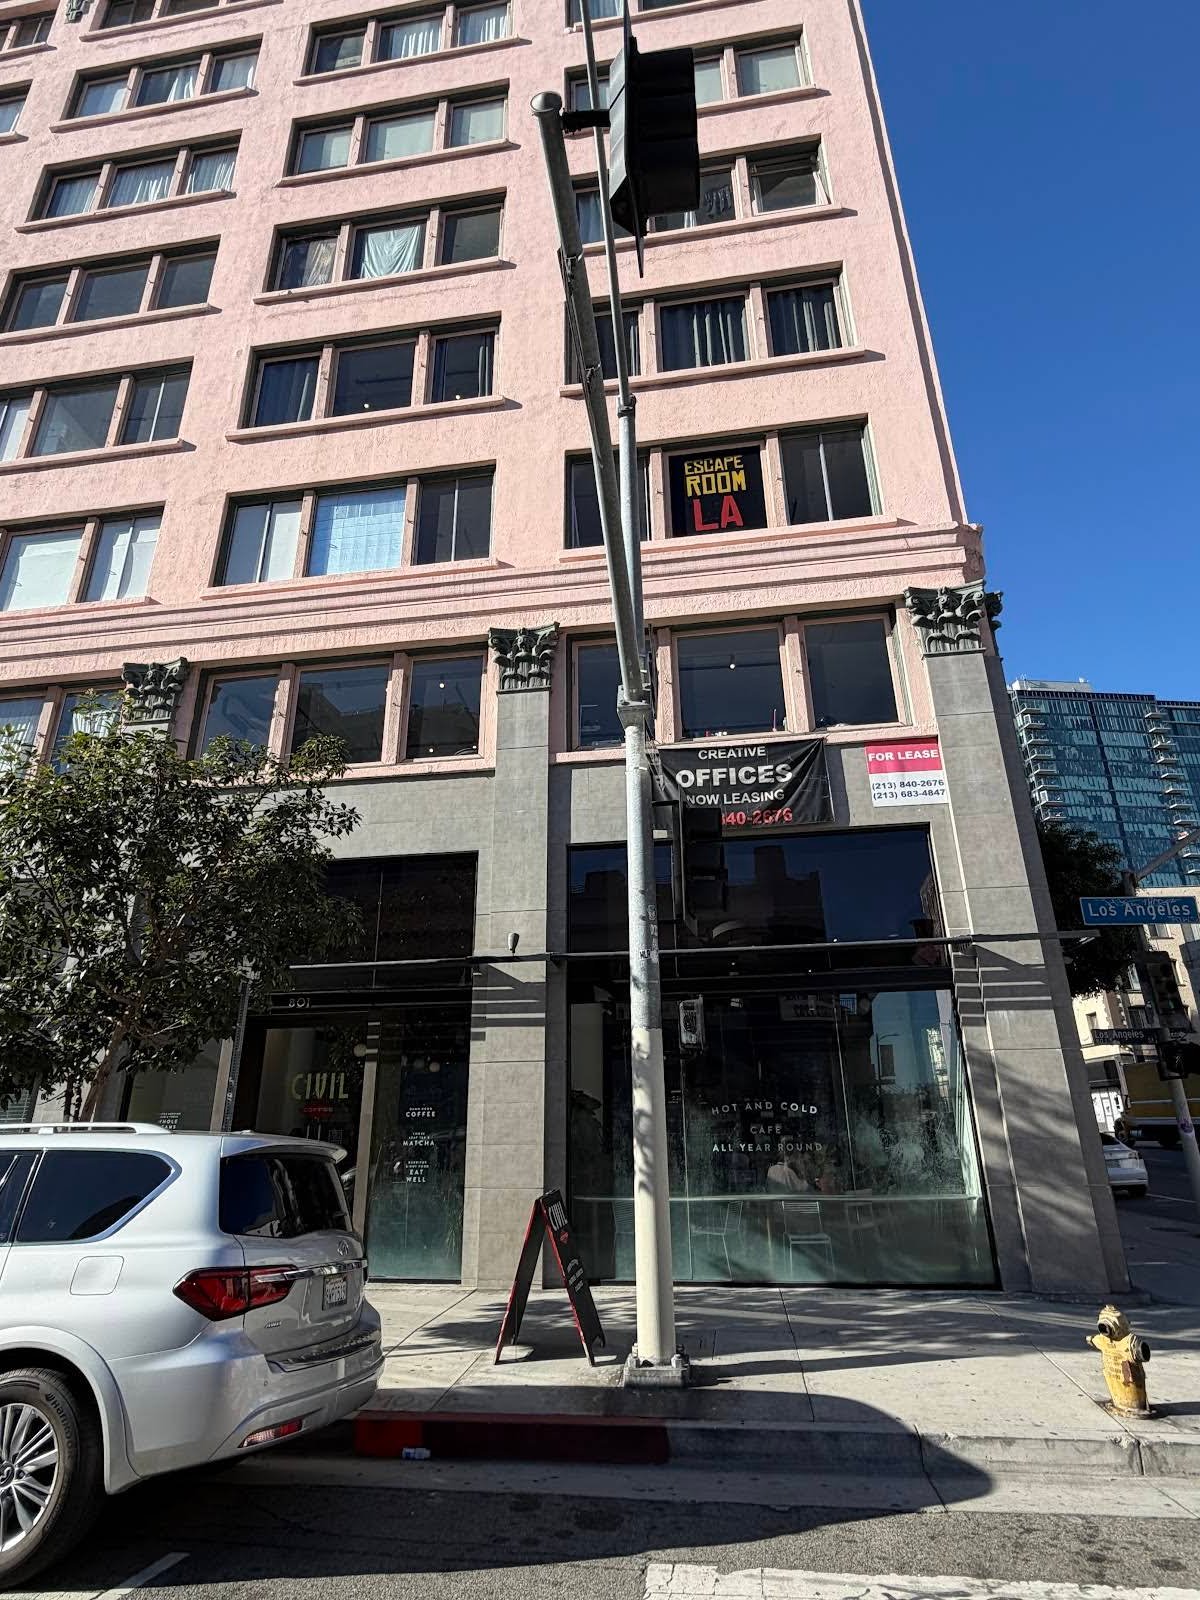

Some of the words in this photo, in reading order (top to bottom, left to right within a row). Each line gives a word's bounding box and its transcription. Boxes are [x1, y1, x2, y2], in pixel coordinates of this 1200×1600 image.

[684, 455, 744, 475] ESCAPE
[686, 470, 747, 497] ROOM
[693, 495, 744, 531] LA
[698, 746, 766, 760] CREATIVE
[868, 752, 894, 761] FOR
[898, 749, 939, 760] LEASE
[675, 763, 793, 788] OFFICES
[872, 782, 897, 791] (213)
[899, 779, 945, 788] 840-2676
[687, 794, 720, 805] NOW
[723, 789, 785, 805] LEASING
[873, 792, 898, 800] (213)
[901, 789, 946, 798] 683-4847
[1088, 903, 1117, 917] Los
[1124, 902, 1191, 920] Angeles
[288, 997, 310, 1008] 801
[1094, 1030, 1109, 1038] Los
[1112, 1029, 1145, 1040] Angeles
[291, 1072, 349, 1100] CIVIL
[711, 1103, 738, 1115] HOT
[744, 1101, 773, 1110] AND
[780, 1102, 818, 1114] COLD
[750, 1125, 782, 1134] CAFE
[712, 1143, 734, 1152] ALL
[739, 1143, 771, 1152] YEAR
[777, 1142, 823, 1152] ROUND
